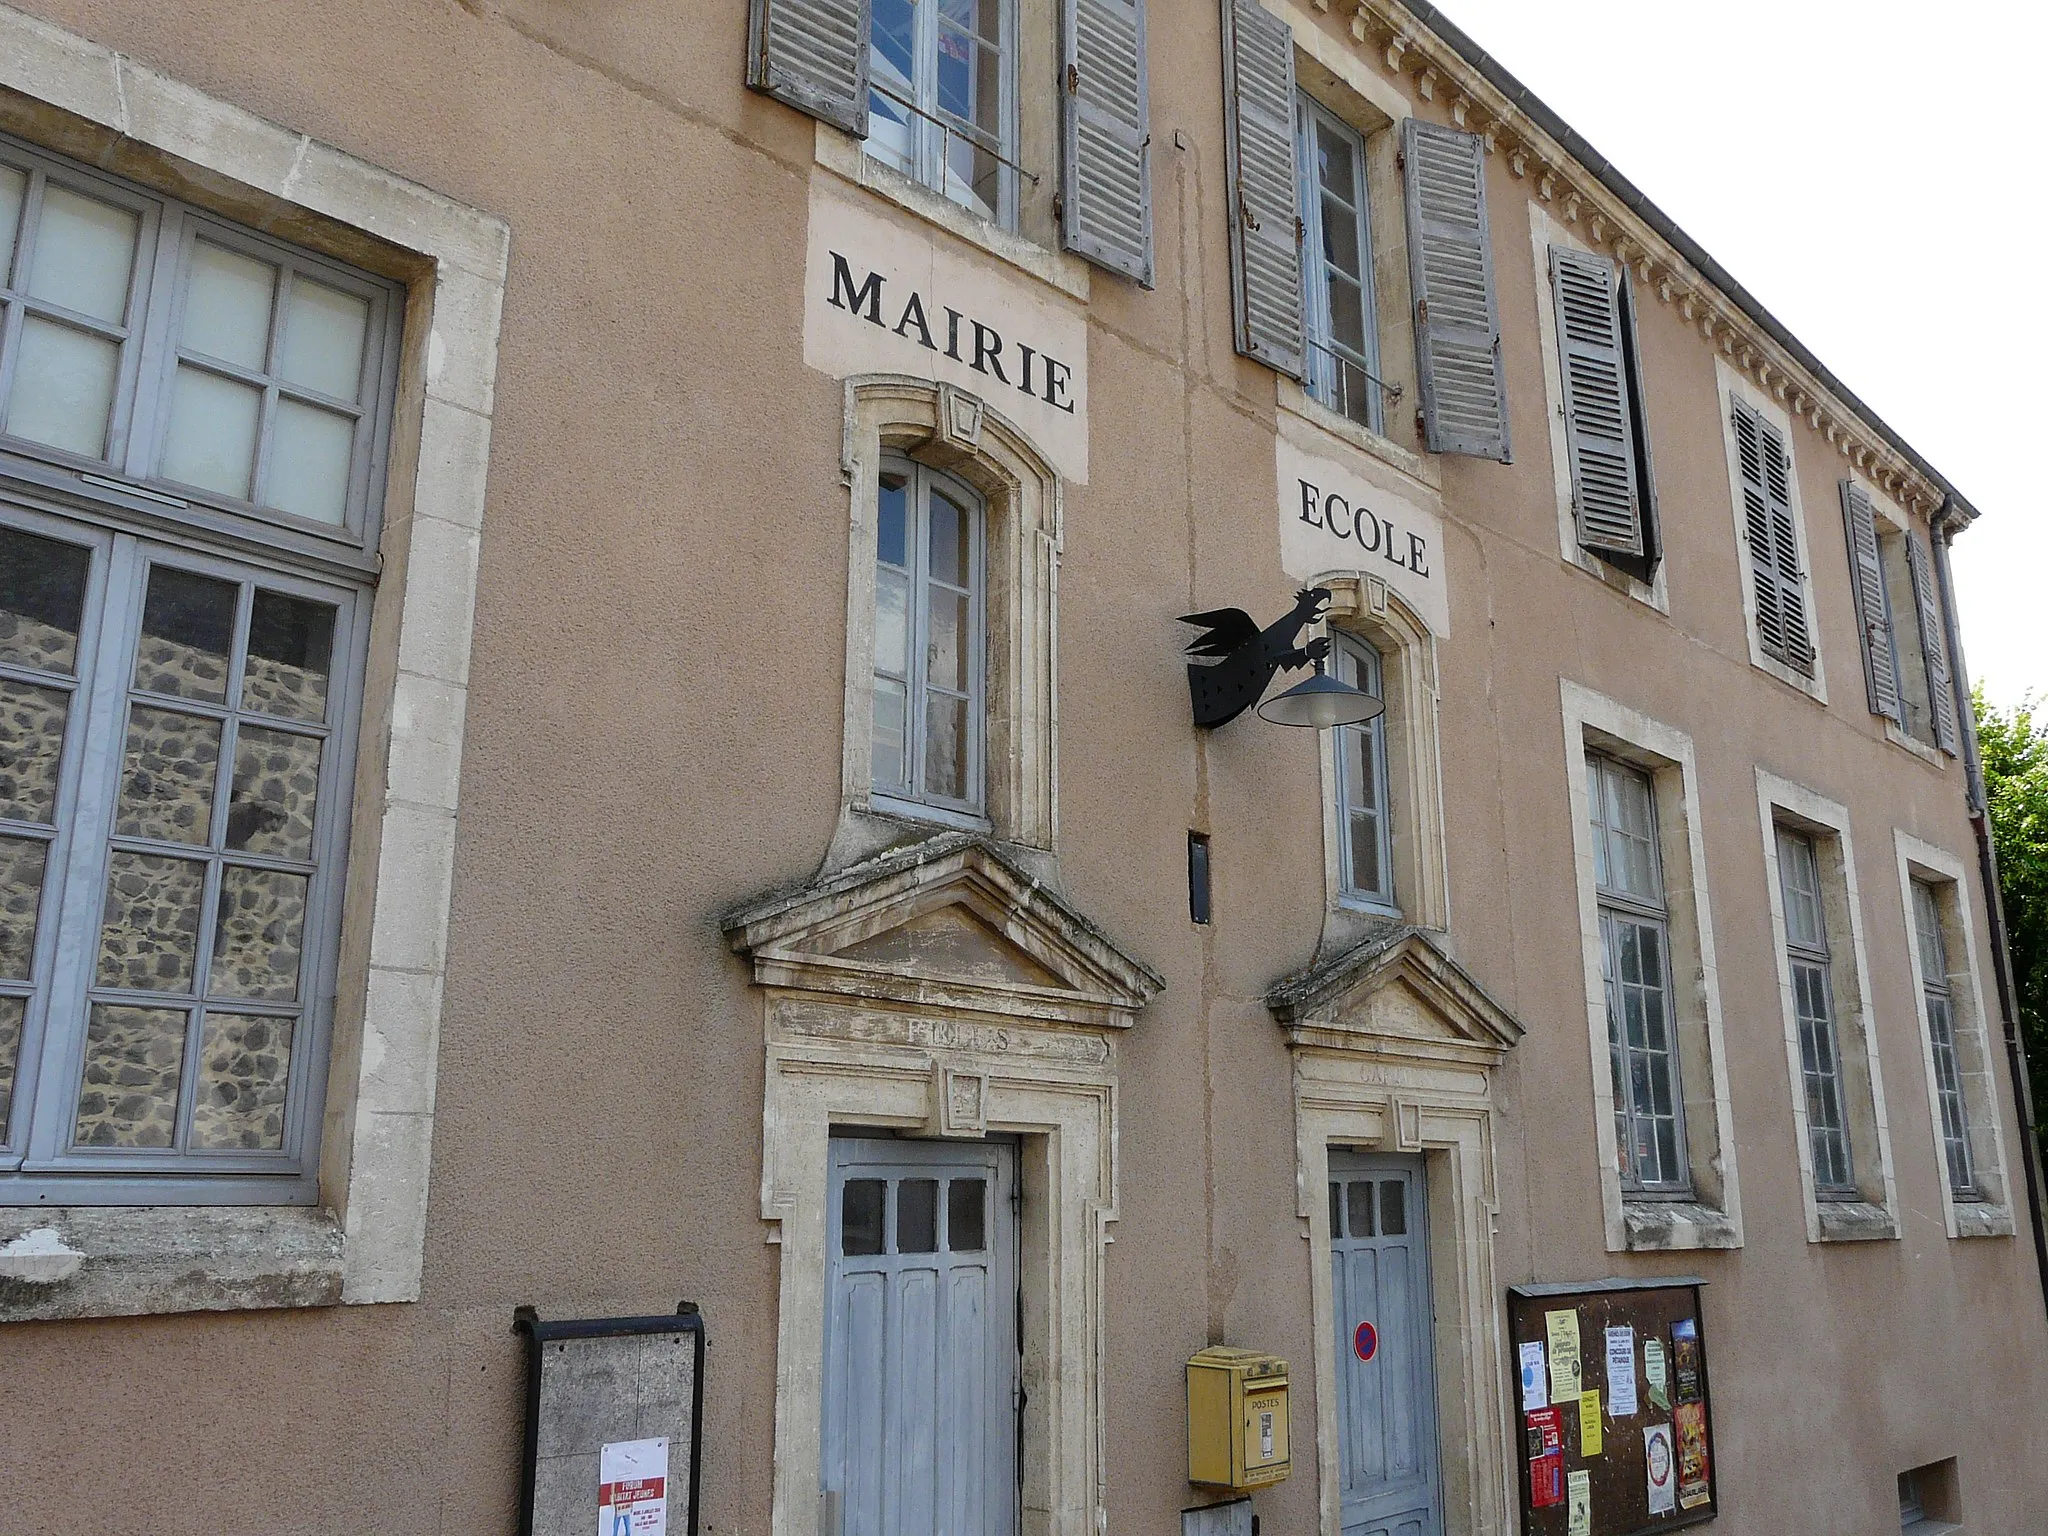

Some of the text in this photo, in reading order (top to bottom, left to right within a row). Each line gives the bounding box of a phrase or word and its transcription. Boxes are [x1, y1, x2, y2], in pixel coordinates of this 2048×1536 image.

[826, 250, 1075, 414] MAIRIE
[1297, 478, 1430, 578] ECOLE
[1252, 1398, 1280, 1410] POSTES
[621, 1479, 643, 1491] FORUM
[632, 1488, 655, 1500] JEUNES
